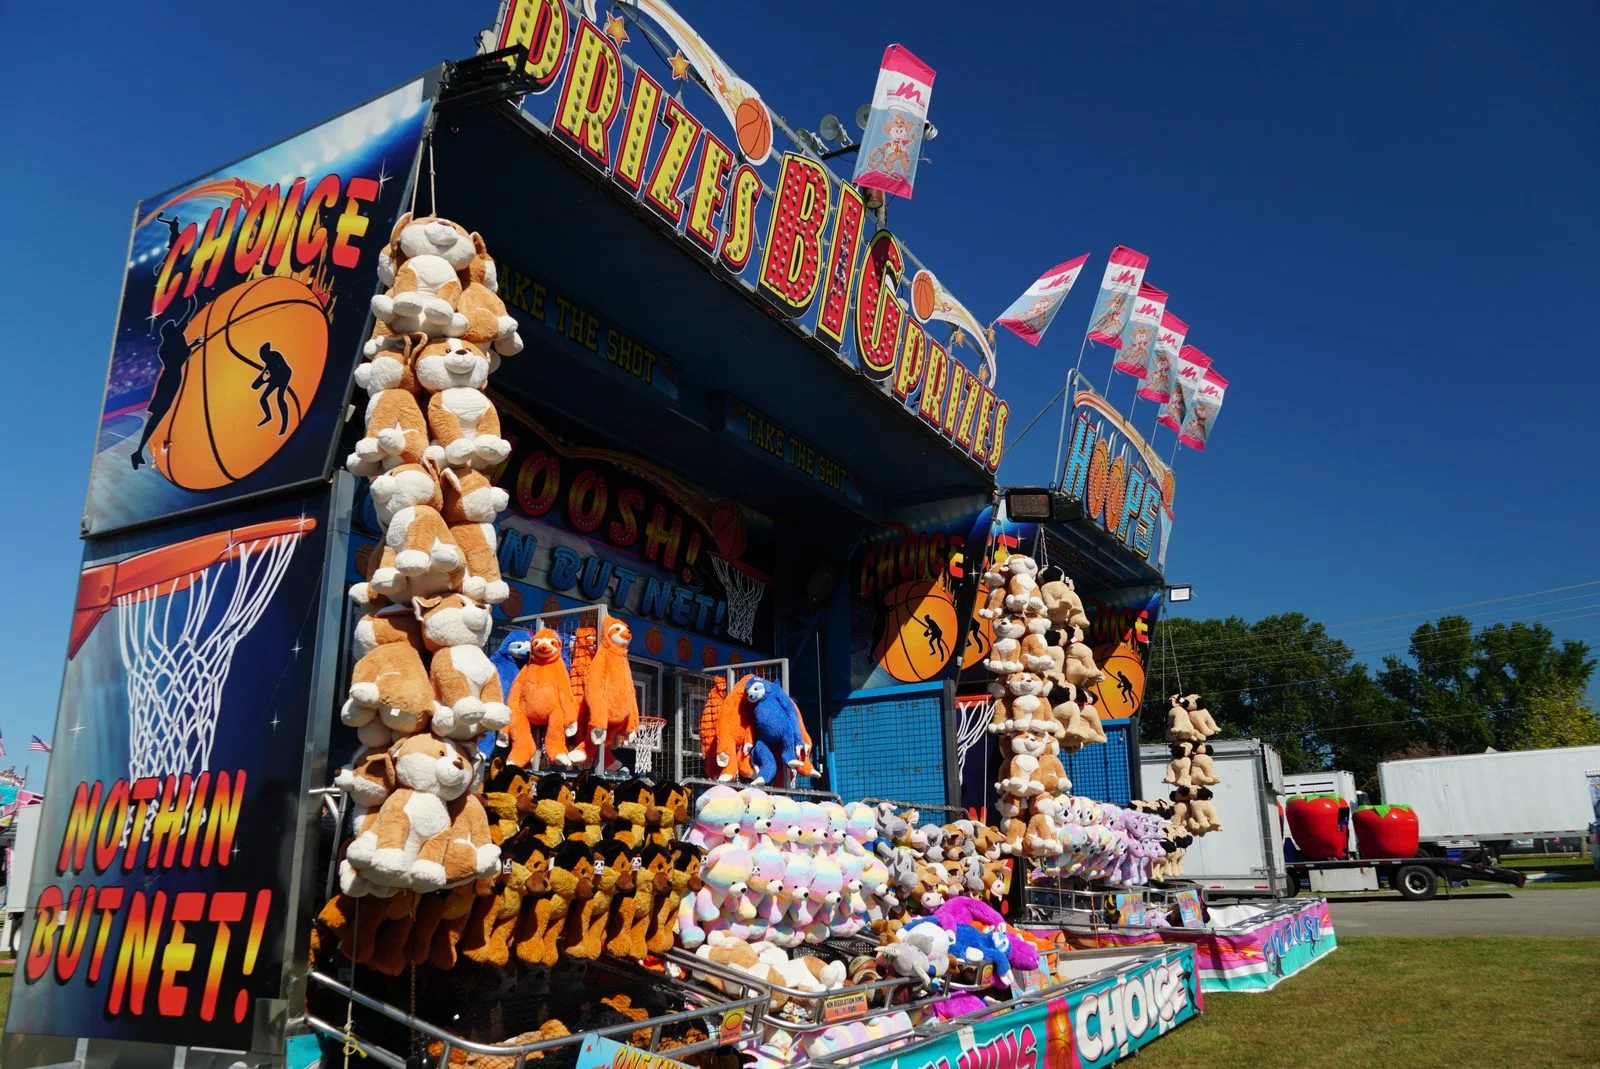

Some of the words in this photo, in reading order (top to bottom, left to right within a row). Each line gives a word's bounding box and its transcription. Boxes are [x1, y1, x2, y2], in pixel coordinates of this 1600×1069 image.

[151, 174, 381, 314] CHOICE
[498, 263, 548, 320] AKE
[555, 296, 601, 351] THE
[606, 327, 658, 384] SHOT
[757, 150, 906, 380] BIG
[893, 314, 1010, 475] PRIZES
[486, 431, 703, 586] OOSH!
[747, 411, 785, 459] TAKE
[788, 437, 815, 476] THE
[818, 455, 849, 494] SHOT
[1060, 412, 1162, 559] HOOPS
[549, 546, 638, 609] BUT
[640, 576, 728, 636] NET!
[860, 532, 967, 600] CHOICE
[58, 769, 248, 875] NOTHIN
[25, 885, 124, 985] BUT
[107, 889, 272, 1025] NET!
[1075, 958, 1188, 1062] CHOICE
